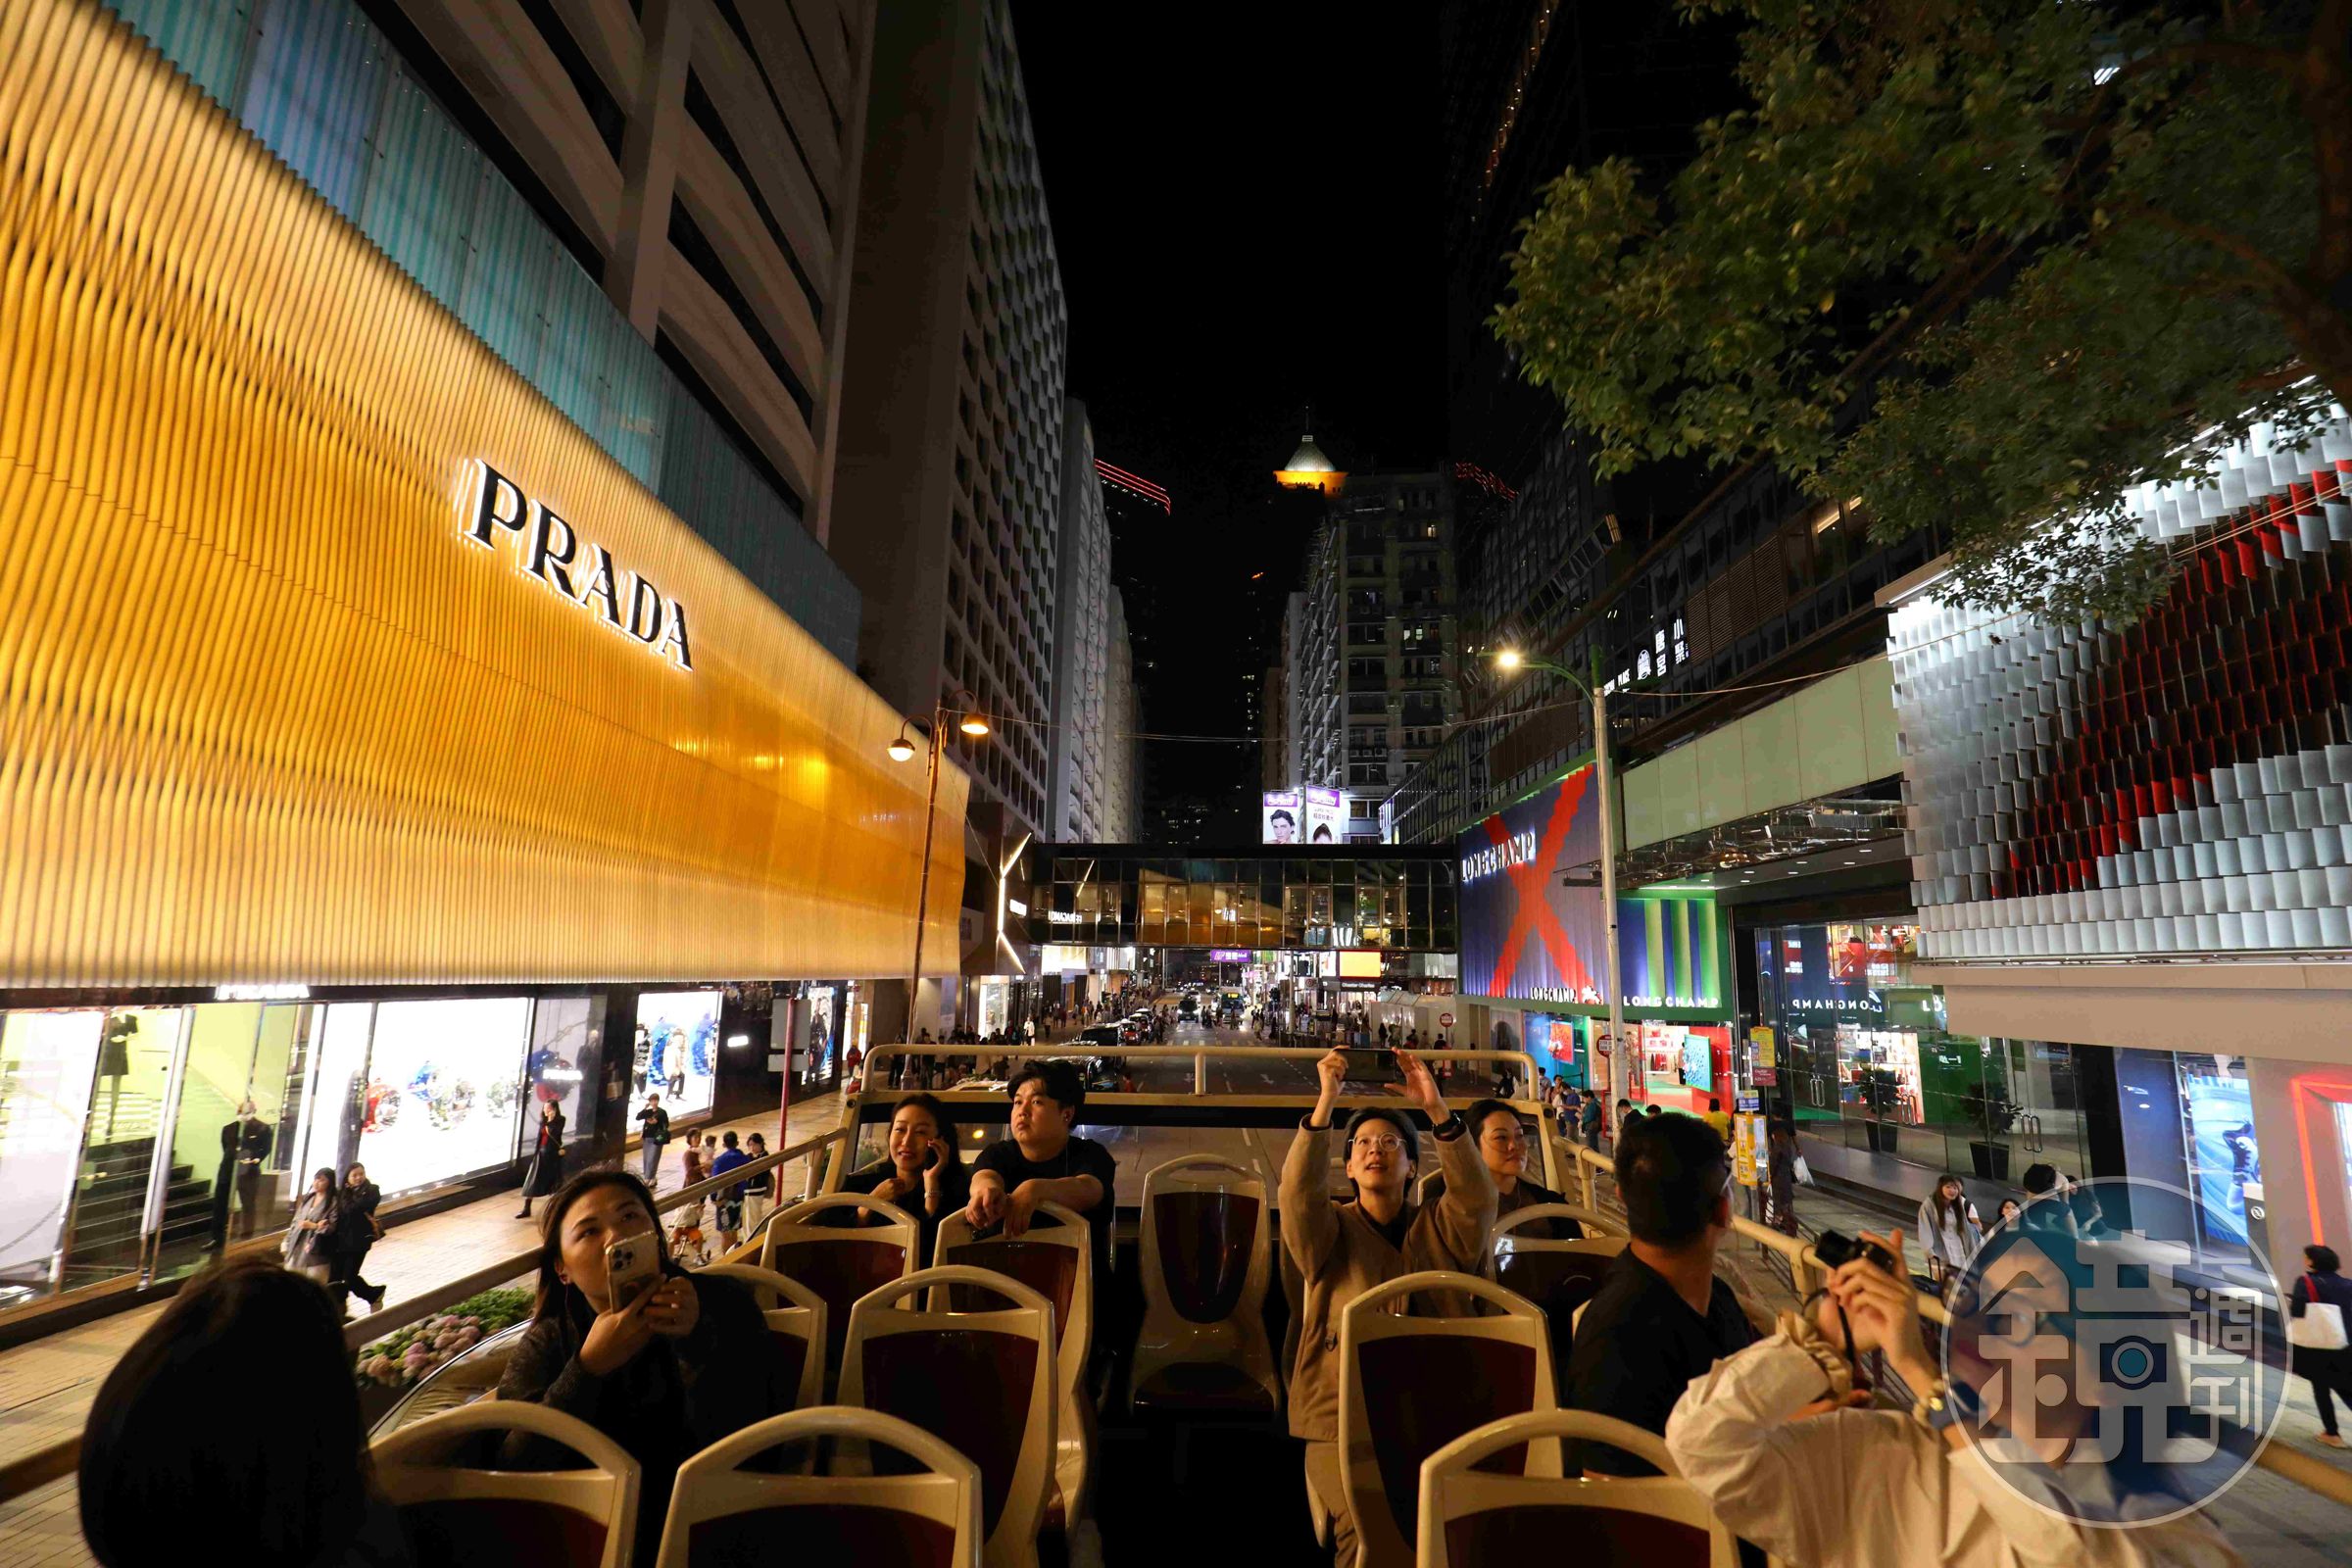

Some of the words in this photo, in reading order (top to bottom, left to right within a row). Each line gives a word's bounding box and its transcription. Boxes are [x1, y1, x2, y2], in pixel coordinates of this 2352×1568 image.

[464, 458, 694, 672] PRADA
[1461, 831, 1536, 882] LONGCHAMP
[1530, 987, 1577, 1004] LONGCHAMP
[1623, 995, 1719, 1008] LONGCHAMP
